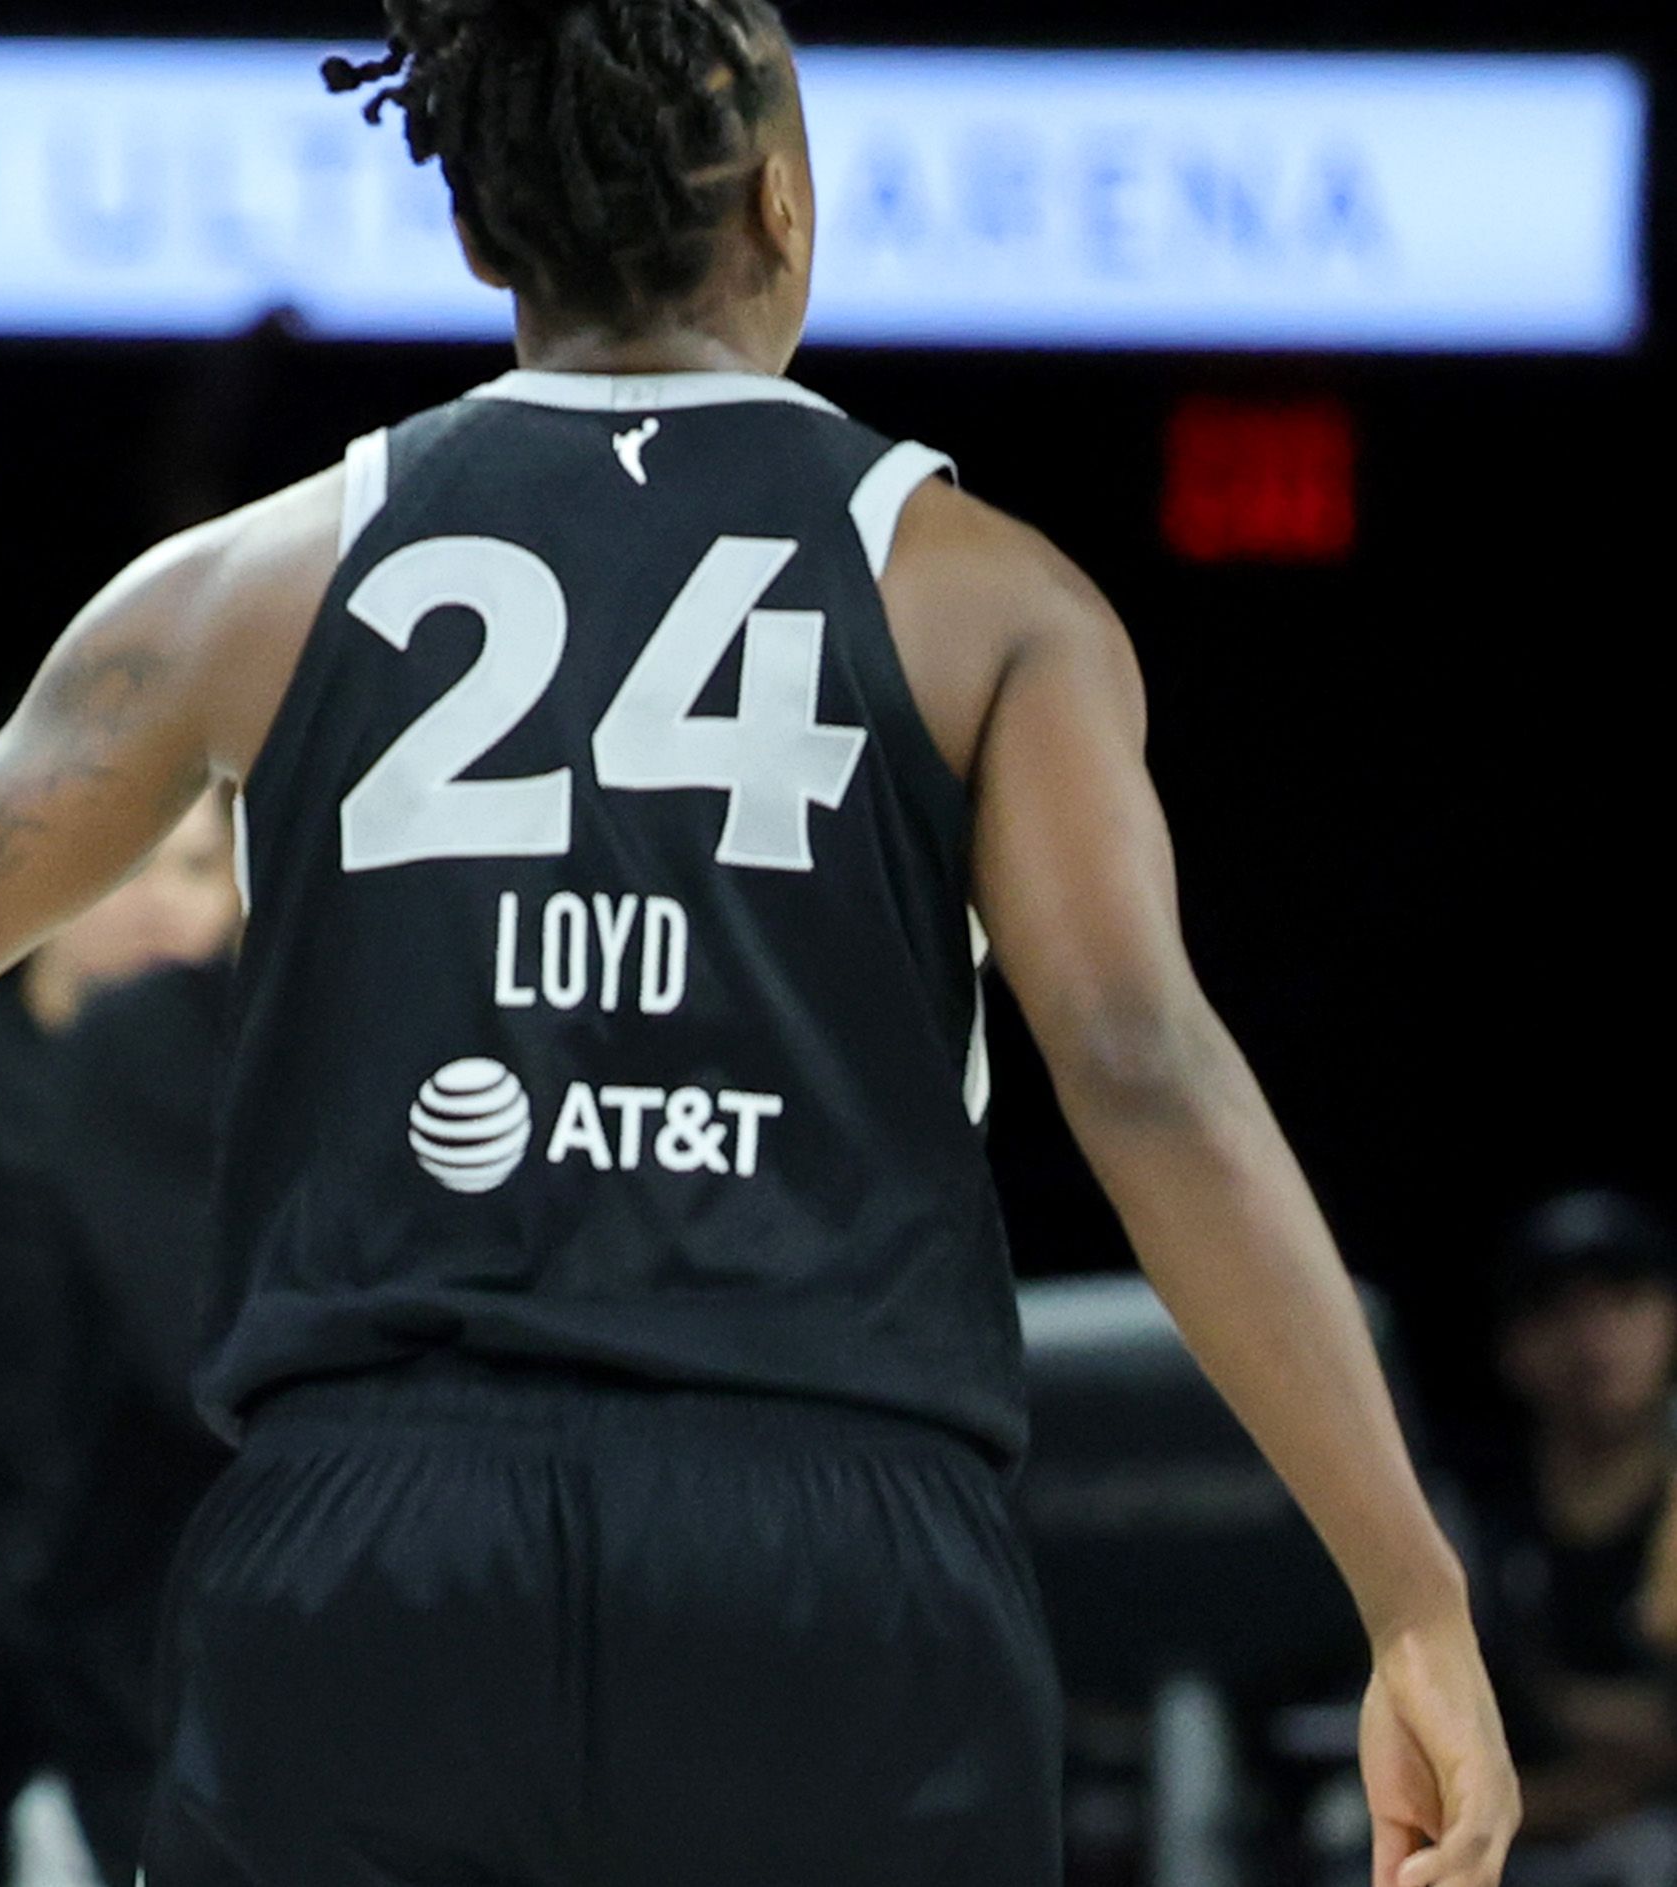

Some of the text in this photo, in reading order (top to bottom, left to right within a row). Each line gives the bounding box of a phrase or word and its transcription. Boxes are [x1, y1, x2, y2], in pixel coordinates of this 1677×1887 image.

[40, 108, 456, 284] ULT
[340, 535, 868, 873] 24
[494, 891, 688, 1015] LOYD
[546, 1081, 784, 1178] AT&T
